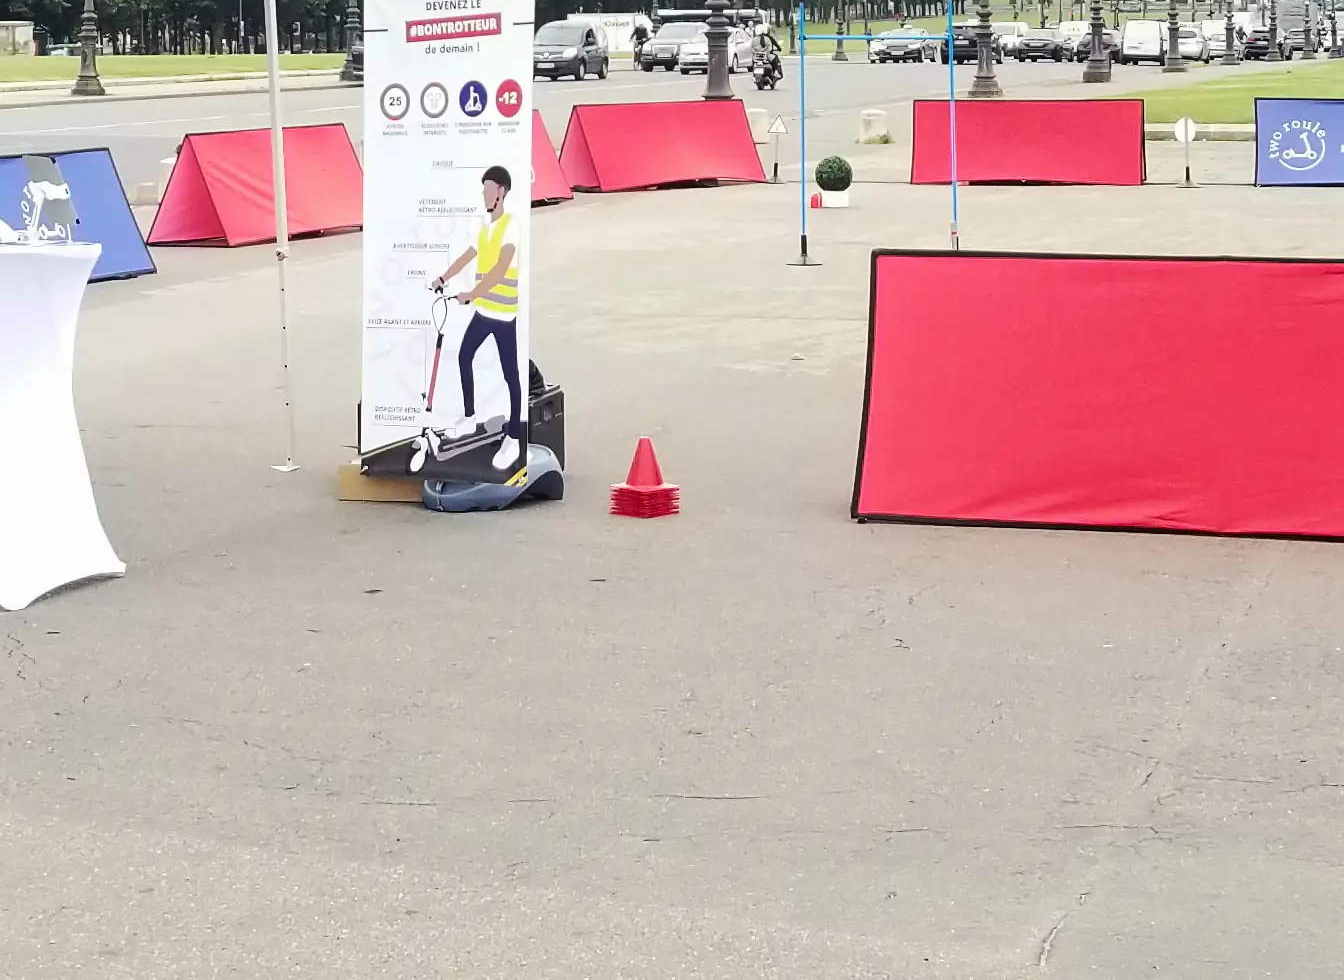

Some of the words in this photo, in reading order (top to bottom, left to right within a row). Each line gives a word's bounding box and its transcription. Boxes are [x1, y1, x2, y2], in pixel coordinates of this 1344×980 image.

[425, 0, 469, 11] DEVENEZ
[409, 17, 498, 38] #BONTROTTEUR
[424, 43, 437, 55] de
[439, 44, 474, 54] demain
[388, 96, 402, 107] 25
[498, 91, 518, 105] -12
[1268, 131, 1283, 159] two
[1282, 120, 1326, 139] roule
